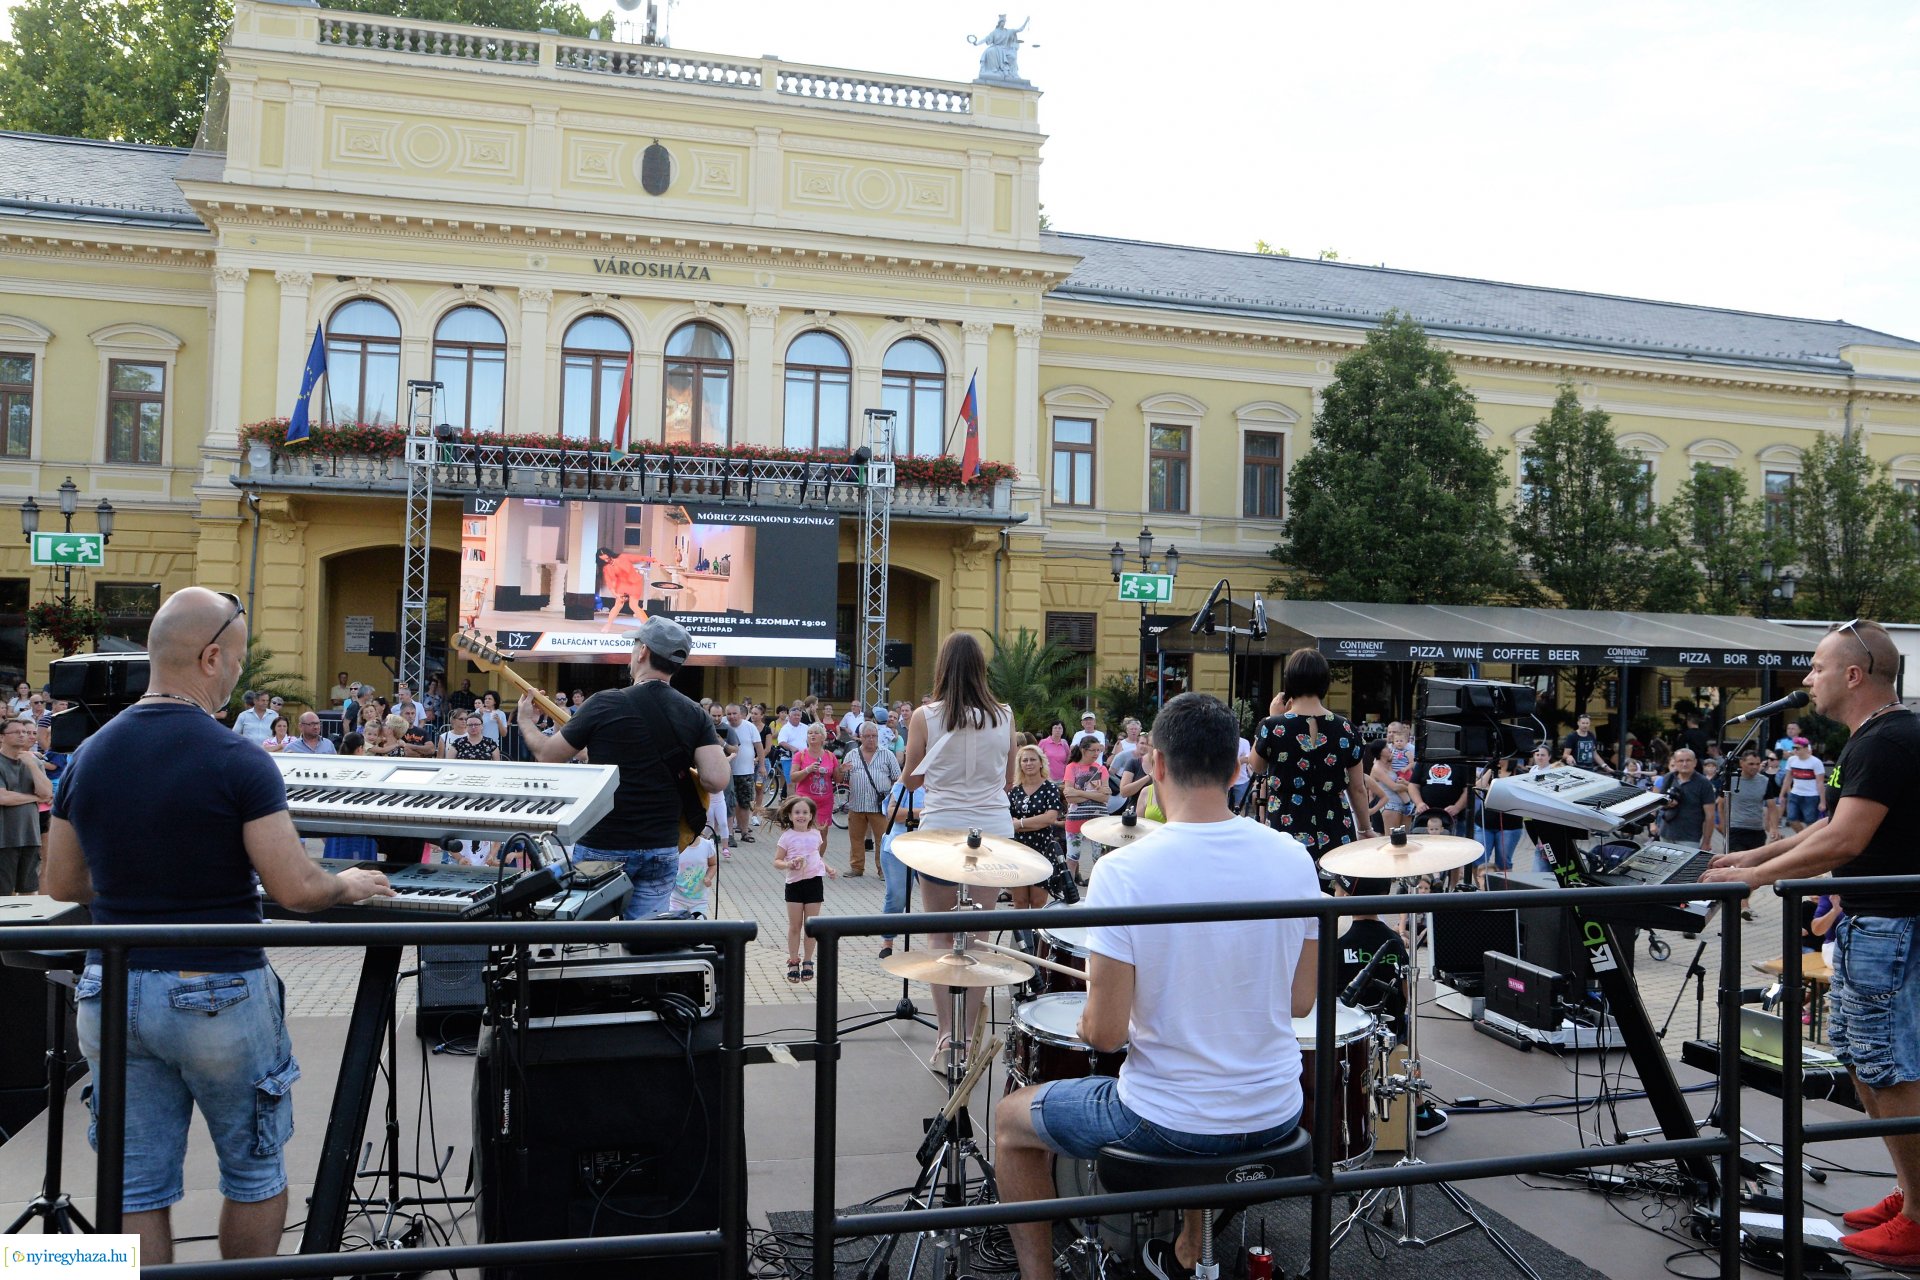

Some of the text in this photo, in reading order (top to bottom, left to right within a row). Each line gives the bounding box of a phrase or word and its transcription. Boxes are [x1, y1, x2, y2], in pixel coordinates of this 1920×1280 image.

[593, 256, 711, 281] VÁROSHÁZA
[697, 511, 835, 526] MÓRICZ ZSIGMOND SZÍNHÁZ
[674, 616, 737, 624] SZEPTEMBER
[739, 617, 753, 625] 26.
[755, 618, 800, 626] SZOMBAT
[551, 637, 597, 646] BALFÁCÁNT
[691, 640, 717, 649] ZÜNET
[1339, 640, 1384, 650] CONTINENT
[1409, 646, 1580, 661] PIZZA WINE COFFEE BEER
[1607, 647, 1647, 657] CONTINENT
[1679, 652, 1813, 666] PIZZA BOR SÖR KÁV
[962, 863, 1020, 872] SABIAN
[469, 903, 490, 917] YAMAHA
[500, 1088, 511, 1135] Soundking
